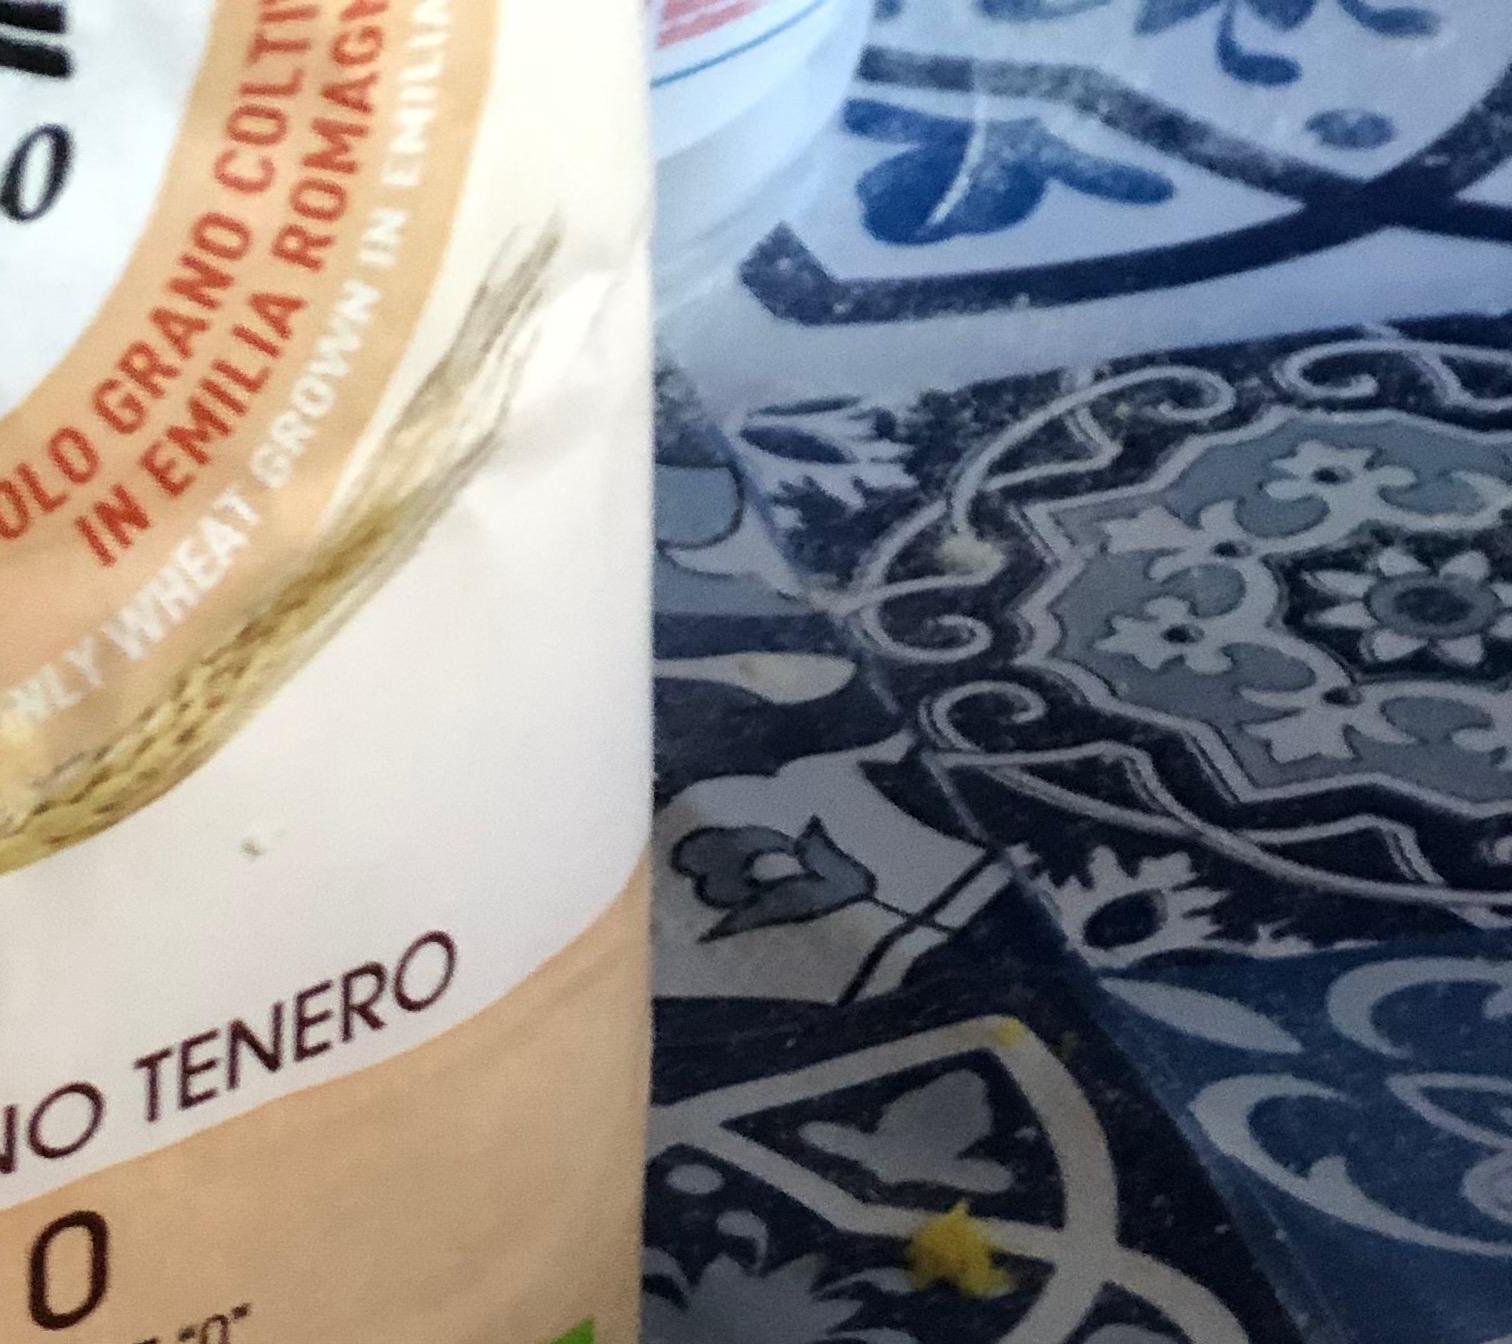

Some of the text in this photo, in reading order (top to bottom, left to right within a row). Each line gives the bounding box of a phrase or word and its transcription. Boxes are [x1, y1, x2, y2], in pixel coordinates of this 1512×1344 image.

[91, 210, 252, 435] GRANO
[212, 0, 321, 195] COLTI
[73, 483, 153, 568] IN
[139, 292, 308, 499] EMILIA
[99, 487, 260, 662] WHEAT
[248, 278, 383, 490] GROWN
[356, 206, 409, 269] IN
[133, 928, 458, 1126] TENERO
[25, 1209, 113, 1332] 0
